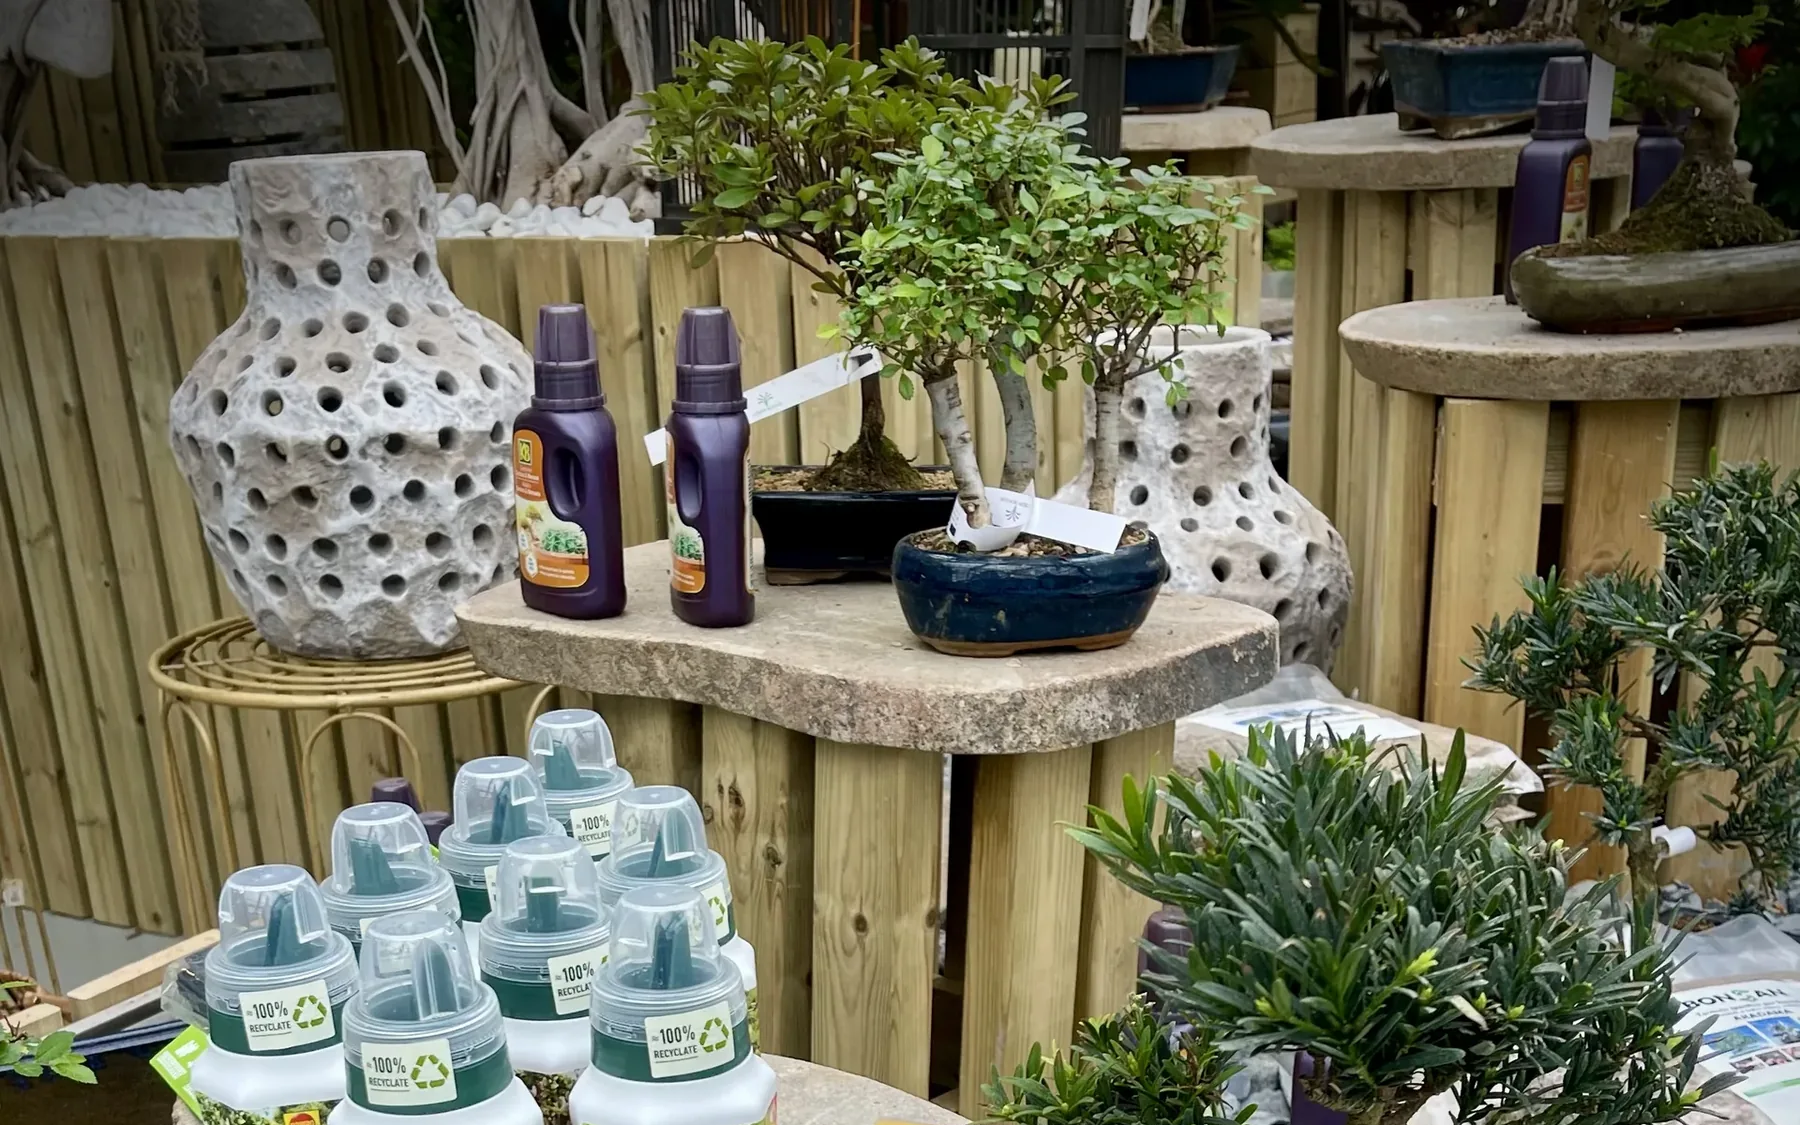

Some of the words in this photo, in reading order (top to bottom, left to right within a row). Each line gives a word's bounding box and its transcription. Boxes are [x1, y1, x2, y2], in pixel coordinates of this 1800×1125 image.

[249, 1020, 292, 1033] RECYCLATE
[654, 1044, 698, 1058] RECYCLATE
[368, 1076, 409, 1088] RECYCLATE
